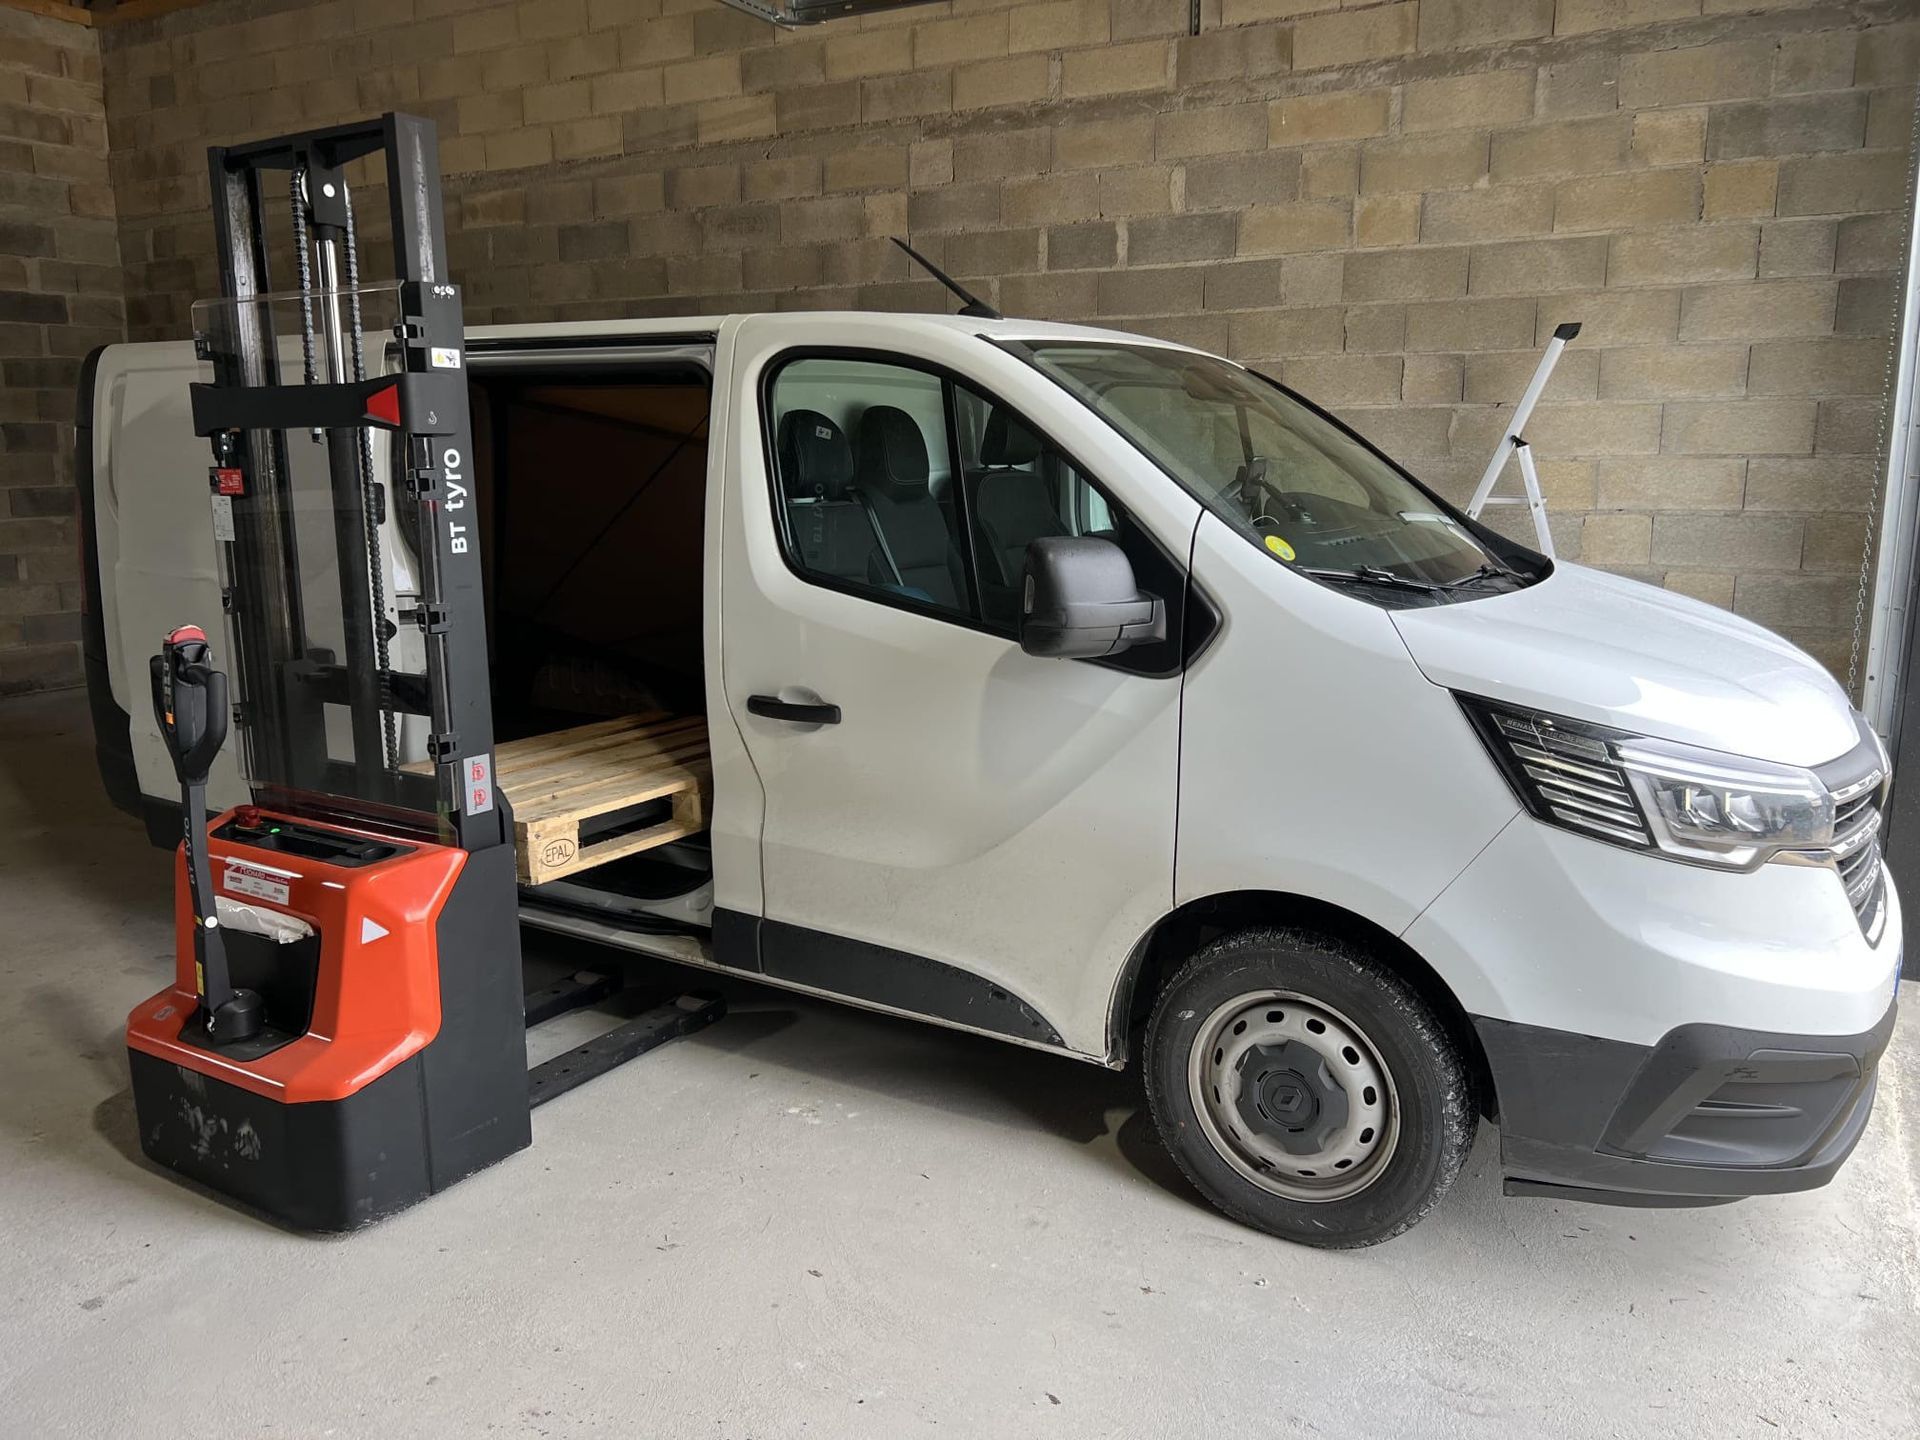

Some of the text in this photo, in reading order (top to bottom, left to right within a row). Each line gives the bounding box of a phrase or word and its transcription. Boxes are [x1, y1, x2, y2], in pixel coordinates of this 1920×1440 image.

[443, 448, 468, 554] BT tyro
[184, 817, 192, 857] tyro
[545, 844, 571, 864] EPAL
